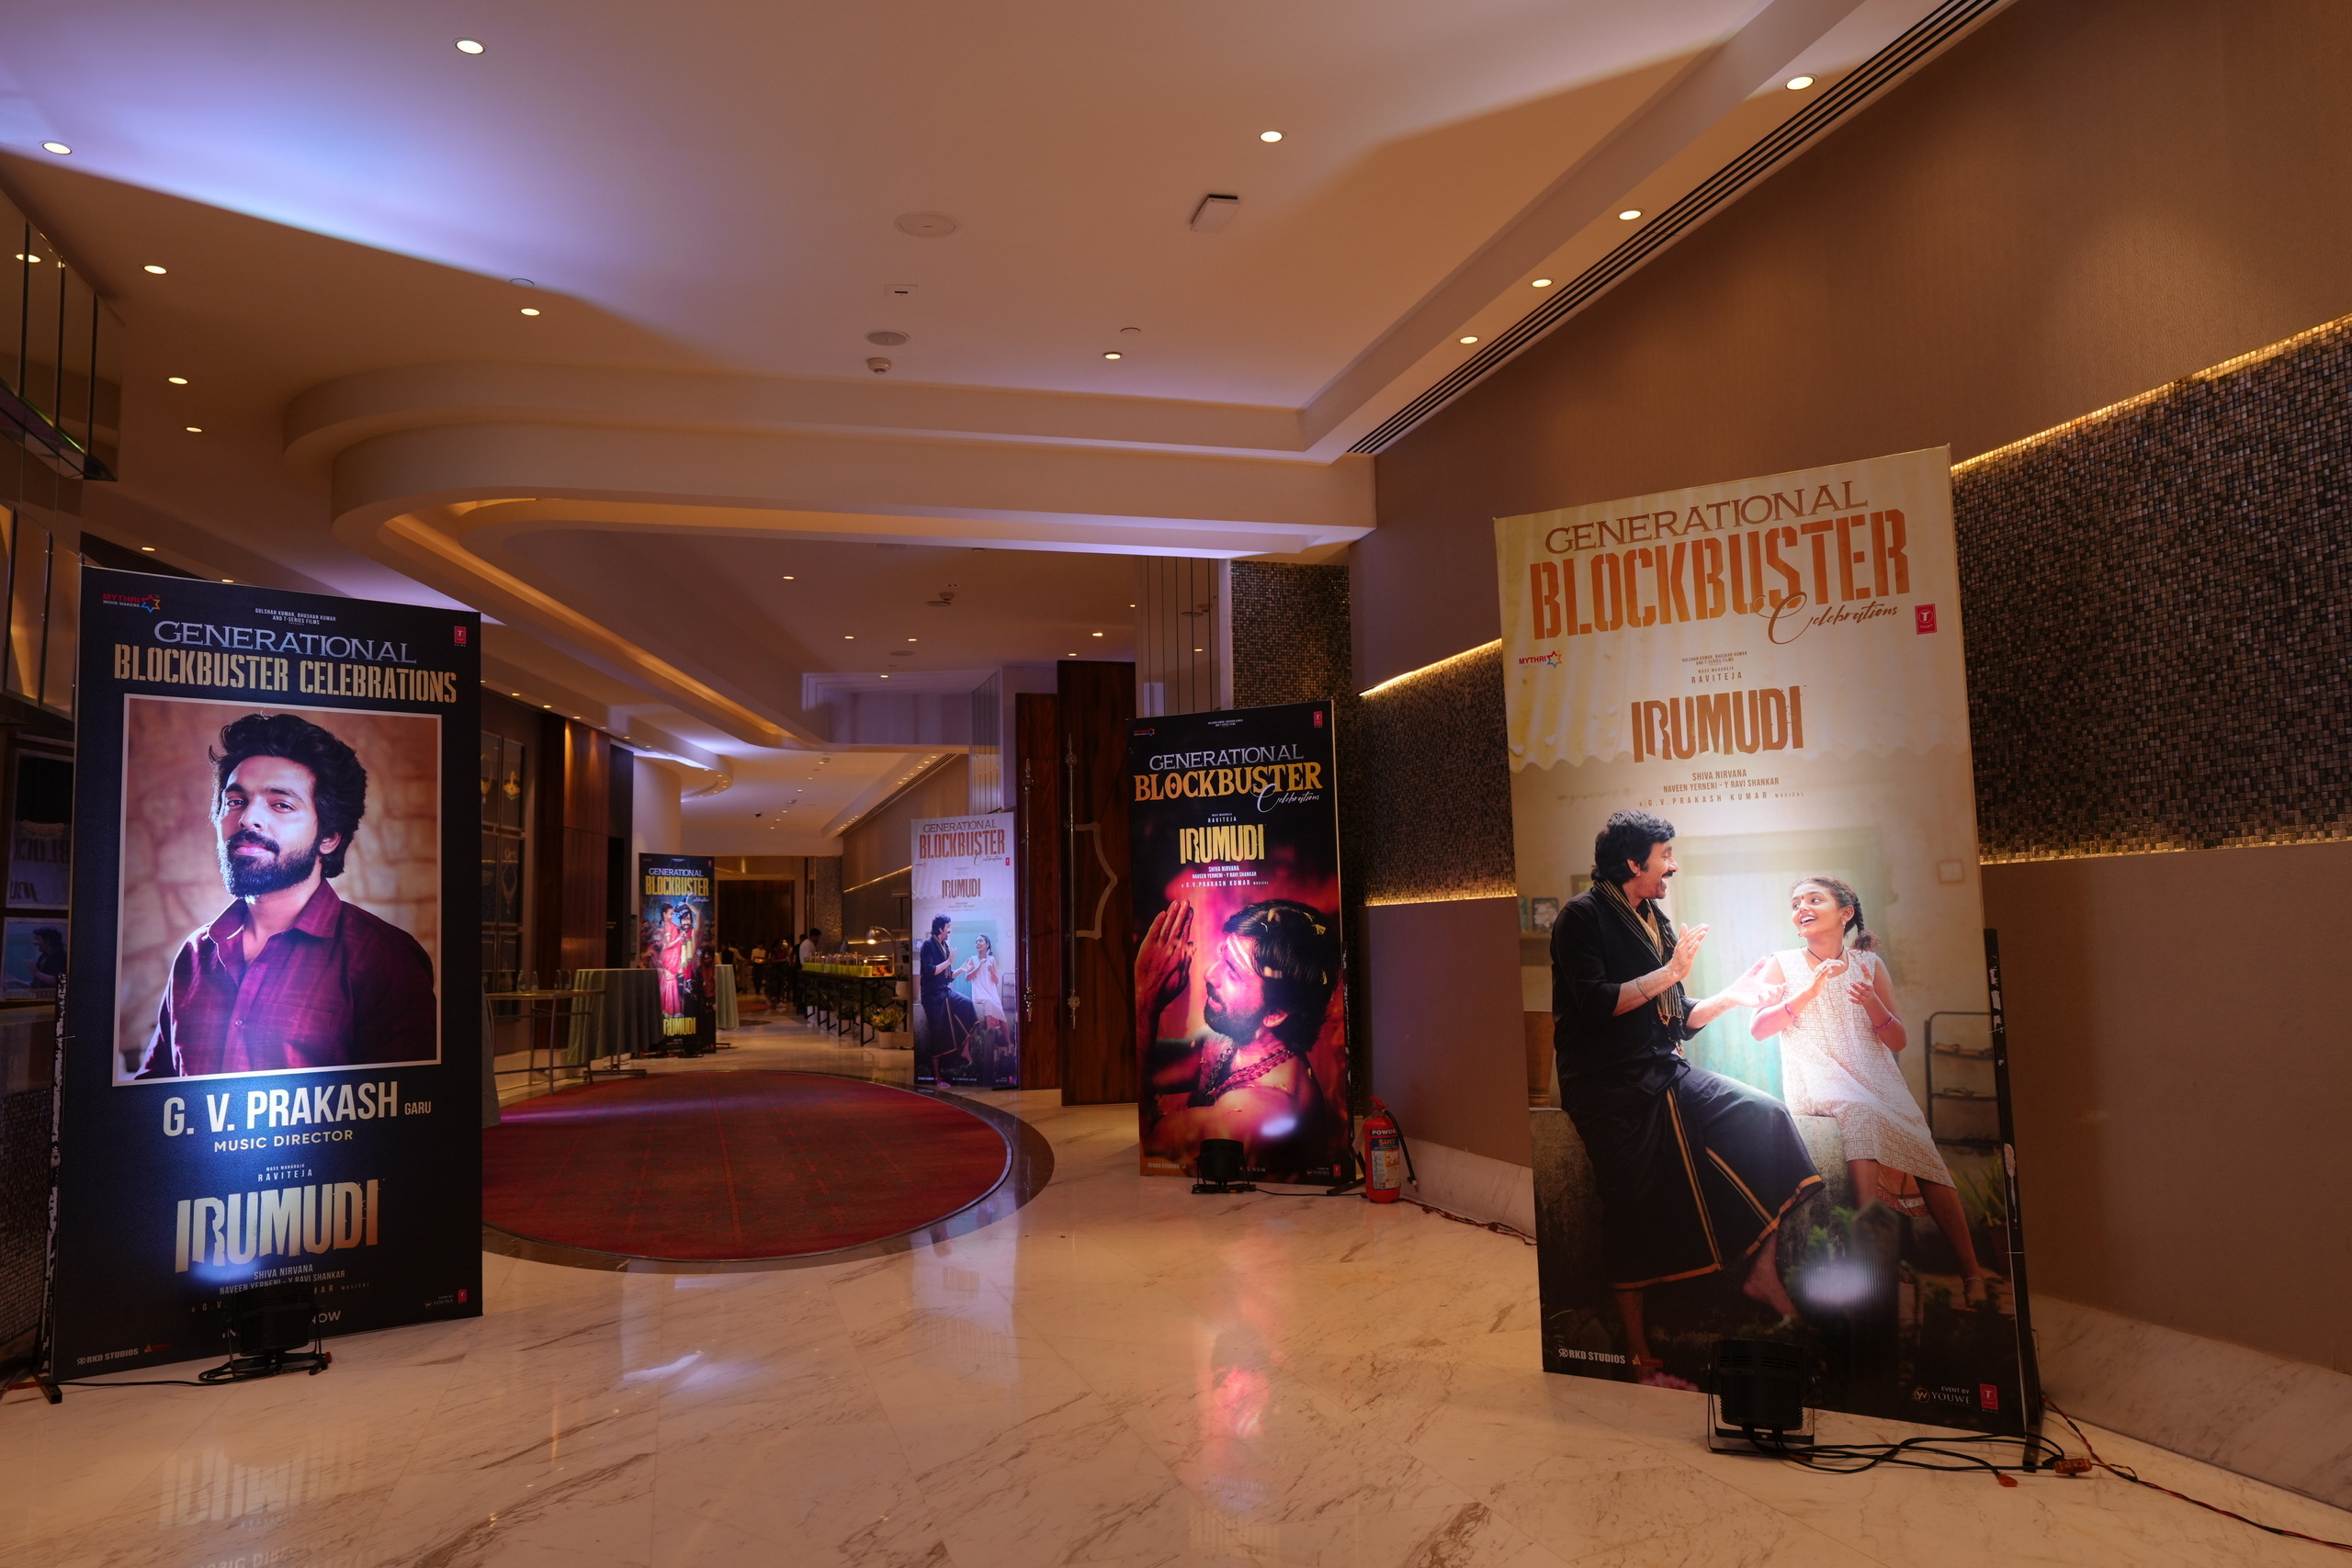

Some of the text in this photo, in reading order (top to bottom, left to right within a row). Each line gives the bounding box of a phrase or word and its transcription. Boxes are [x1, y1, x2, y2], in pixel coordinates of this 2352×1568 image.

[1545, 479, 1868, 555] GENERATIONAL
[1530, 508, 1910, 640] BLOCKBUSTER
[1752, 591, 1900, 645] Celebrations
[153, 620, 417, 664] GENERATIONAL
[1519, 656, 1547, 665] MYTHRI
[114, 644, 458, 704] BLOCKBUSTER CELEBRATIONS
[1691, 671, 1742, 683] RAVITEJA
[1631, 684, 1804, 764] IRUMUDI
[1149, 744, 1304, 771] GENERATIONAL
[1134, 761, 1323, 801] BLOCKBUSTER
[1663, 784, 1688, 793] NAVEEN
[1690, 782, 1717, 791] YERNENI
[1731, 780, 1746, 788] RAVI
[1747, 777, 1780, 786] SHANKAR
[1692, 769, 1747, 781] SHIVA NIRVANA
[1250, 783, 1320, 813] Celebrations
[1731, 792, 1768, 801] KUMAR
[923, 819, 998, 832] GENERATIONAL
[920, 829, 1005, 859] BLOCKBUSTER
[1180, 823, 1265, 863] IRUMUDI
[649, 868, 704, 876] GENERATIONAL
[645, 875, 709, 897] BLOCKBUSTER
[942, 878, 980, 898] IRUMUDI
[663, 1017, 696, 1036] RUMUDI
[163, 1081, 432, 1137] G. V. PRAKASH GARU
[214, 1130, 354, 1153] MUSIC DIRECTOR
[257, 1168, 313, 1182] RAVITEJA
[175, 1179, 379, 1273] IRUMUDI
[219, 1284, 248, 1295] NAVEEN
[312, 1270, 345, 1281] SHANKAR
[254, 1264, 313, 1280] SHIVA NIRVANA
[86, 1348, 139, 1363] RKD STUDIOS
[1569, 1349, 1587, 1359] RKD
[1588, 1352, 1626, 1364] STUDIOS
[1931, 1392, 1971, 1404] YOUWE
